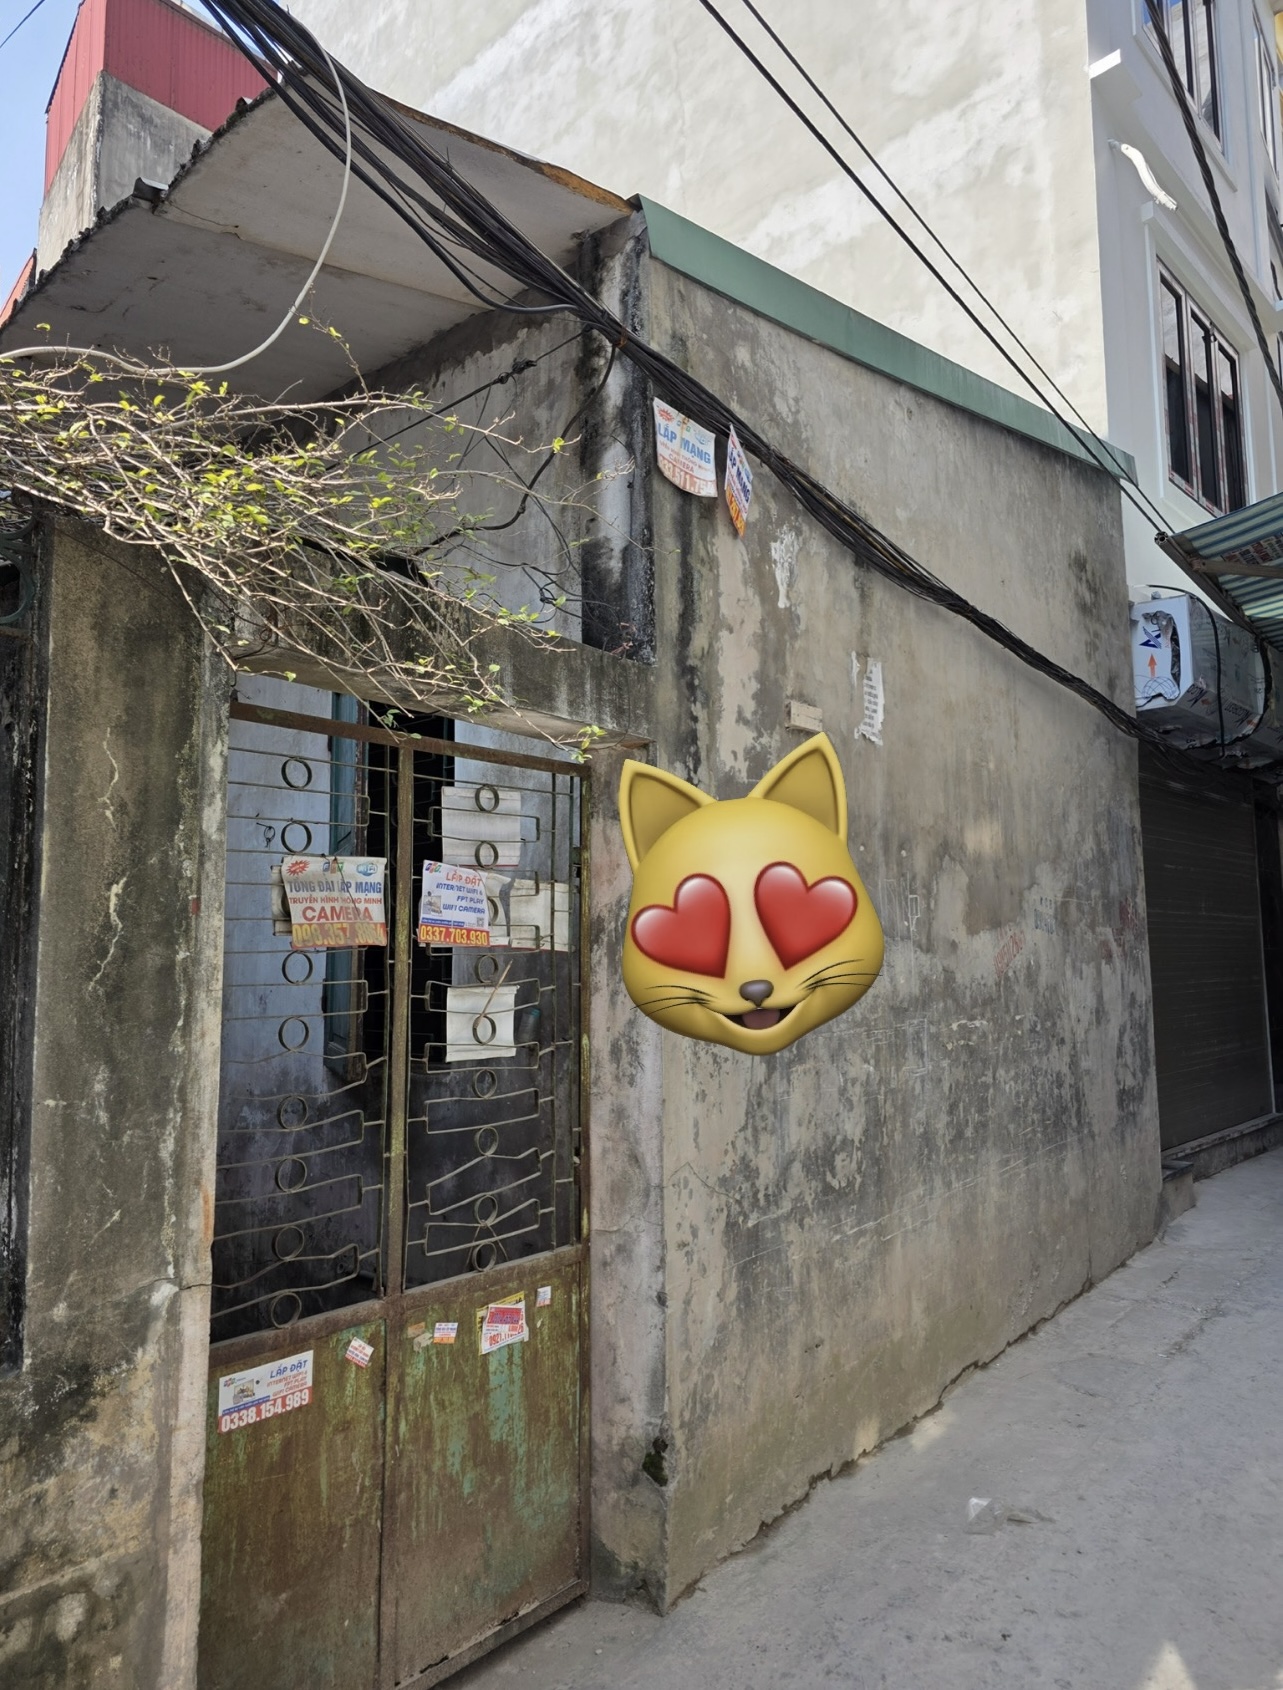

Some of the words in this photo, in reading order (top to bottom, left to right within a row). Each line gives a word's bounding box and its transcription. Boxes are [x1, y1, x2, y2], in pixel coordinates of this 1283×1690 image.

[680, 438, 711, 464] MẠNG
[355, 881, 382, 896] MẠNG
[363, 897, 383, 905] MINH
[456, 895, 469, 903] FPT
[302, 906, 373, 922] CAMERA
[458, 905, 486, 915] CAMERA
[420, 925, 488, 945] 0337.703.930
[270, 1363, 288, 1379] LẮP
[290, 1359, 308, 1375] ĐẶT
[221, 1388, 309, 1433] 0338.154.989
